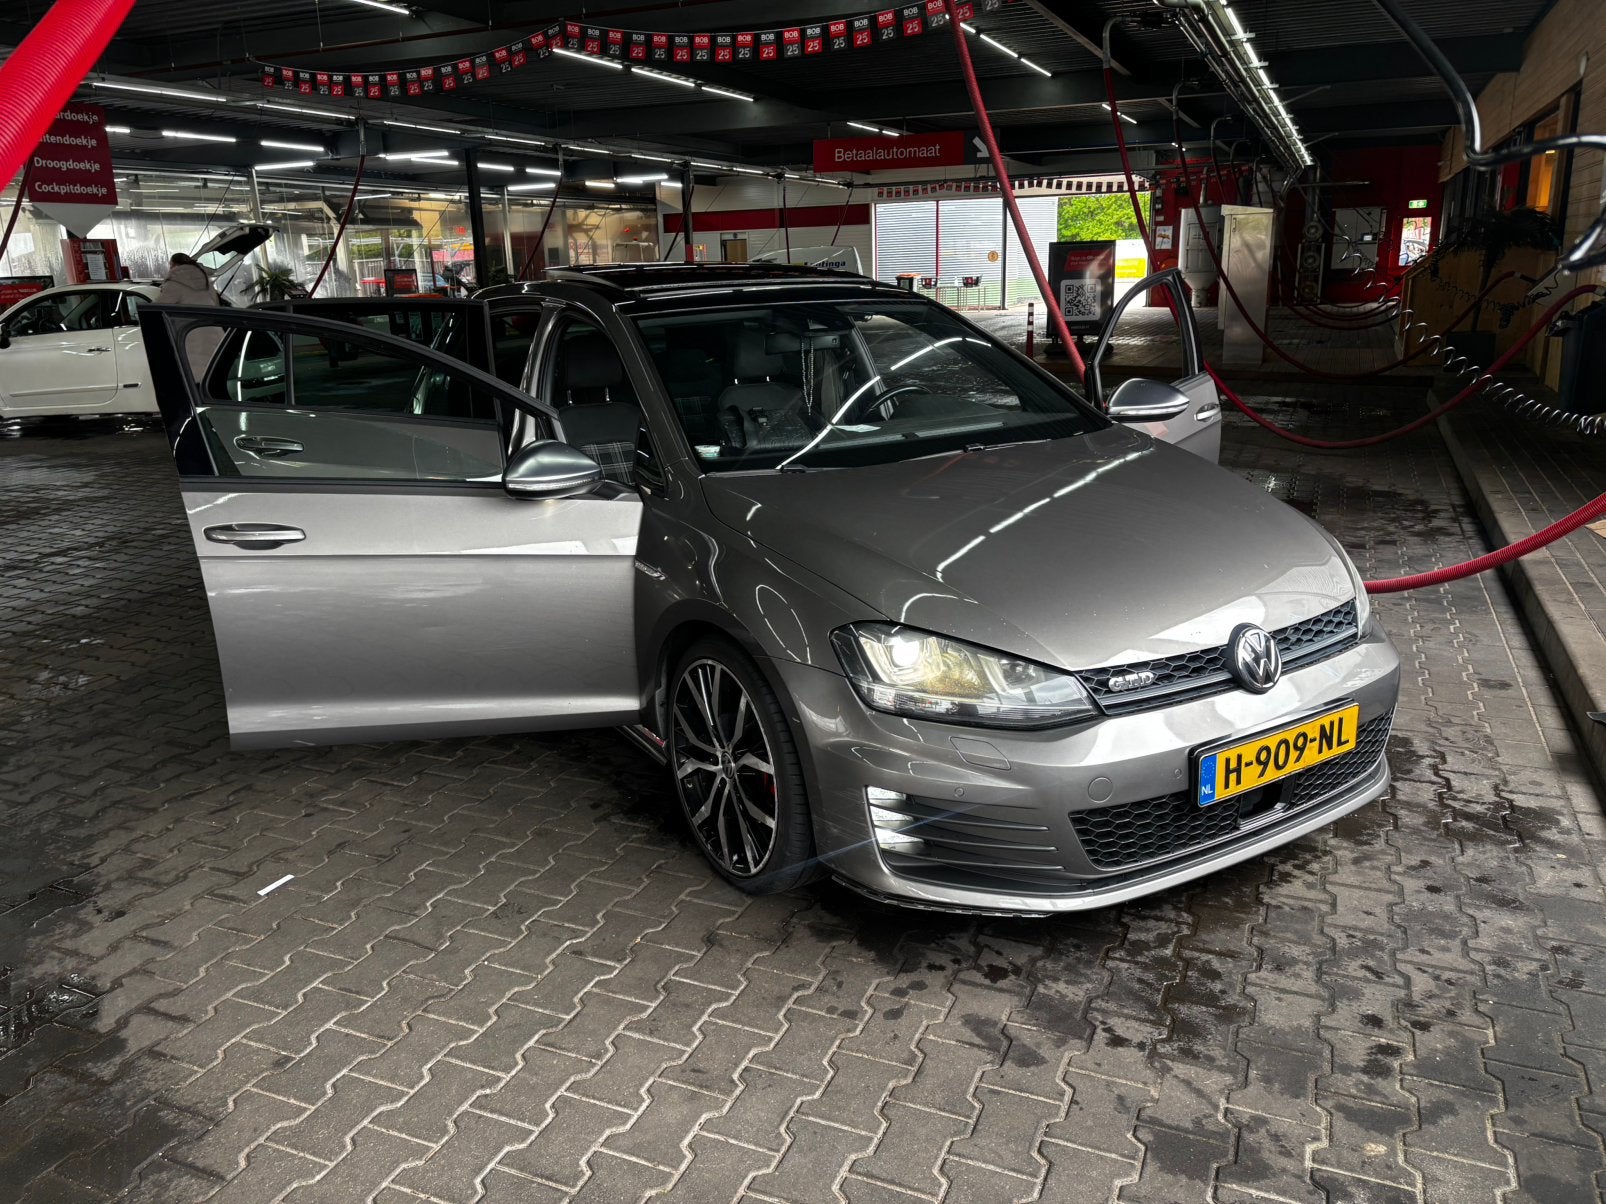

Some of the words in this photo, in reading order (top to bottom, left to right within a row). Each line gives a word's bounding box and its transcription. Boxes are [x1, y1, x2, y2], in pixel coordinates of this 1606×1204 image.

[928, 0, 943, 9] BOB
[903, 6, 918, 16] BOB
[957, 6, 970, 19] 25
[878, 12, 893, 22] BOB
[931, 14, 944, 27] 25
[831, 24, 844, 32] BOB
[854, 19, 868, 28] BOB
[907, 21, 919, 33] 25
[587, 28, 599, 36] BOB
[609, 31, 621, 39] BOB
[632, 33, 645, 41] BOB
[761, 33, 775, 41] BOB
[882, 27, 894, 40] 25
[552, 37, 561, 48] 25
[568, 39, 578, 48] 25
[834, 37, 845, 49] 25
[857, 32, 868, 45] 25
[587, 42, 597, 51] 25
[609, 45, 620, 55] 25
[787, 44, 799, 55] 25
[807, 40, 819, 51] 25
[538, 47, 549, 59] 25
[632, 47, 643, 57] 25
[654, 48, 665, 58] 25
[677, 50, 688, 60] 25
[696, 50, 708, 60] 25
[719, 49, 730, 59] 25
[739, 48, 750, 58] 25
[763, 47, 774, 57] 25
[515, 53, 524, 64] 25
[479, 67, 487, 78] 25
[501, 62, 511, 73] 25
[264, 77, 272, 86] 25
[445, 78, 454, 88] 25
[463, 73, 473, 83] 25
[284, 81, 293, 90] 25
[301, 84, 309, 92] 25
[320, 86, 328, 94] 25
[333, 86, 342, 94] 25
[390, 86, 399, 95] 25
[410, 84, 419, 93] 25
[423, 81, 433, 90] 25
[354, 88, 363, 96] 25
[370, 87, 379, 96] 25
[834, 143, 940, 162] Betaalautomaat
[34, 157, 101, 173] Droogdoekje
[35, 181, 108, 197] Cockpitdoekje
[1108, 671, 1155, 692] GTD
[1224, 716, 1350, 790] H-909-NL
[1201, 784, 1214, 796] NL
